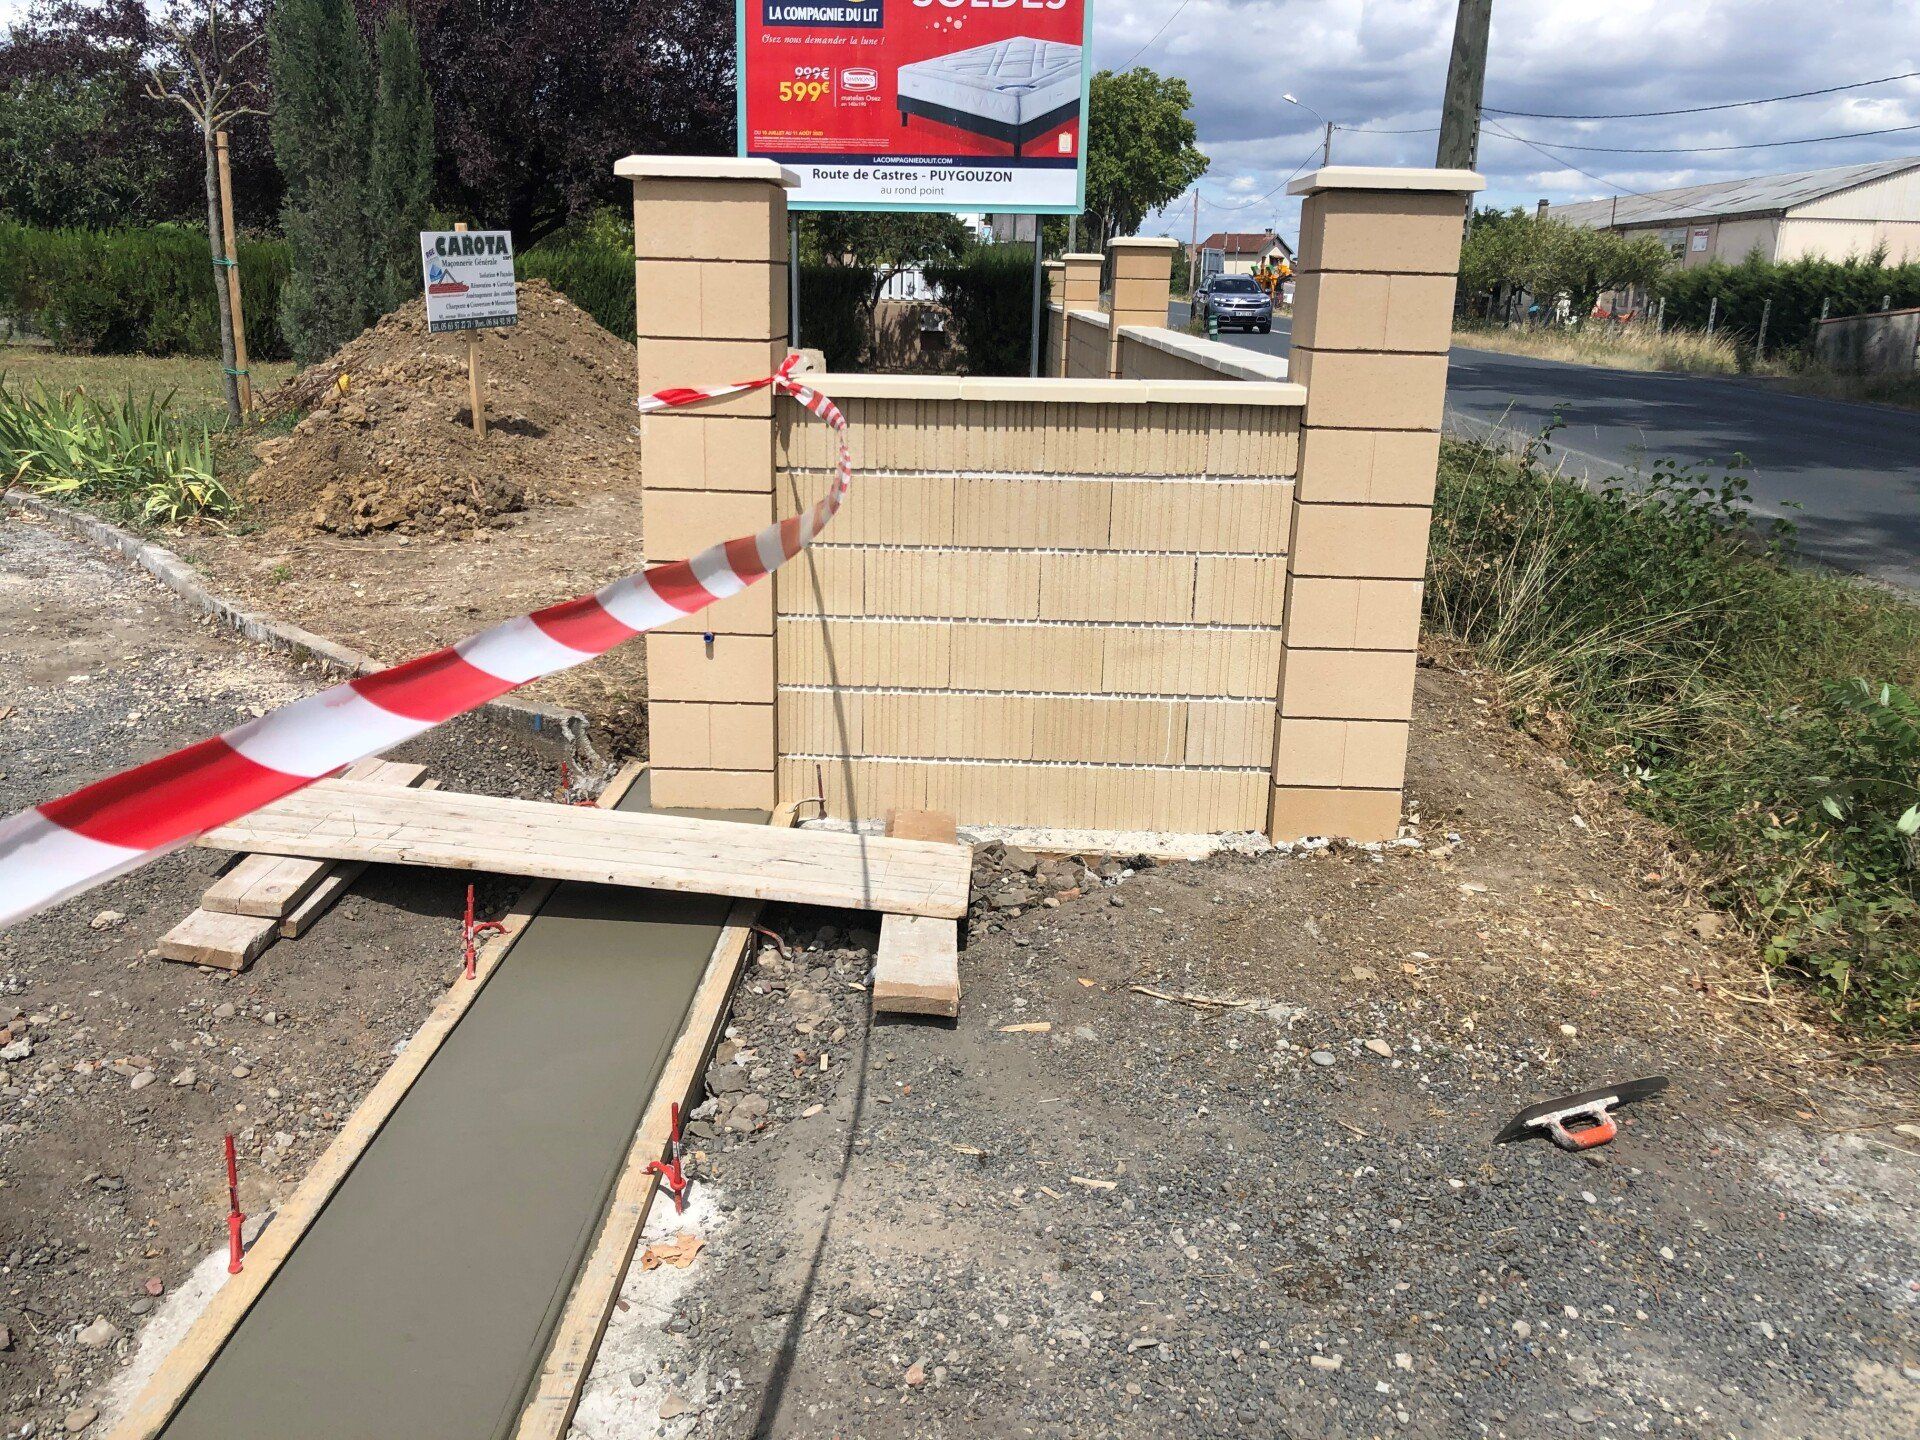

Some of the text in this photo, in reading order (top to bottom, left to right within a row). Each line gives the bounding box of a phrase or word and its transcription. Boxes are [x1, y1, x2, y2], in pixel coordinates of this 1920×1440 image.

[769, 6, 879, 22] LA COMPAGNIE DU LIT
[762, 33, 781, 44] Osez
[784, 35, 802, 44] nous
[805, 34, 846, 45] demander
[850, 36, 858, 45] la
[861, 36, 877, 45] lune
[795, 66, 830, 80] 999€
[845, 75, 874, 83] SIMMONS
[779, 81, 830, 102] 599€
[865, 94, 881, 102] Osez
[873, 156, 953, 164] LACOMPAGNIEDULIT.COM
[812, 168, 849, 180] Route
[853, 168, 868, 180] de
[872, 169, 918, 181] Castres
[930, 169, 1013, 183] PUYGOUZON
[880, 186, 944, 197] au rond point
[435, 234, 509, 256] CAROTA
[441, 258, 497, 268] Maçonnerie Générale
